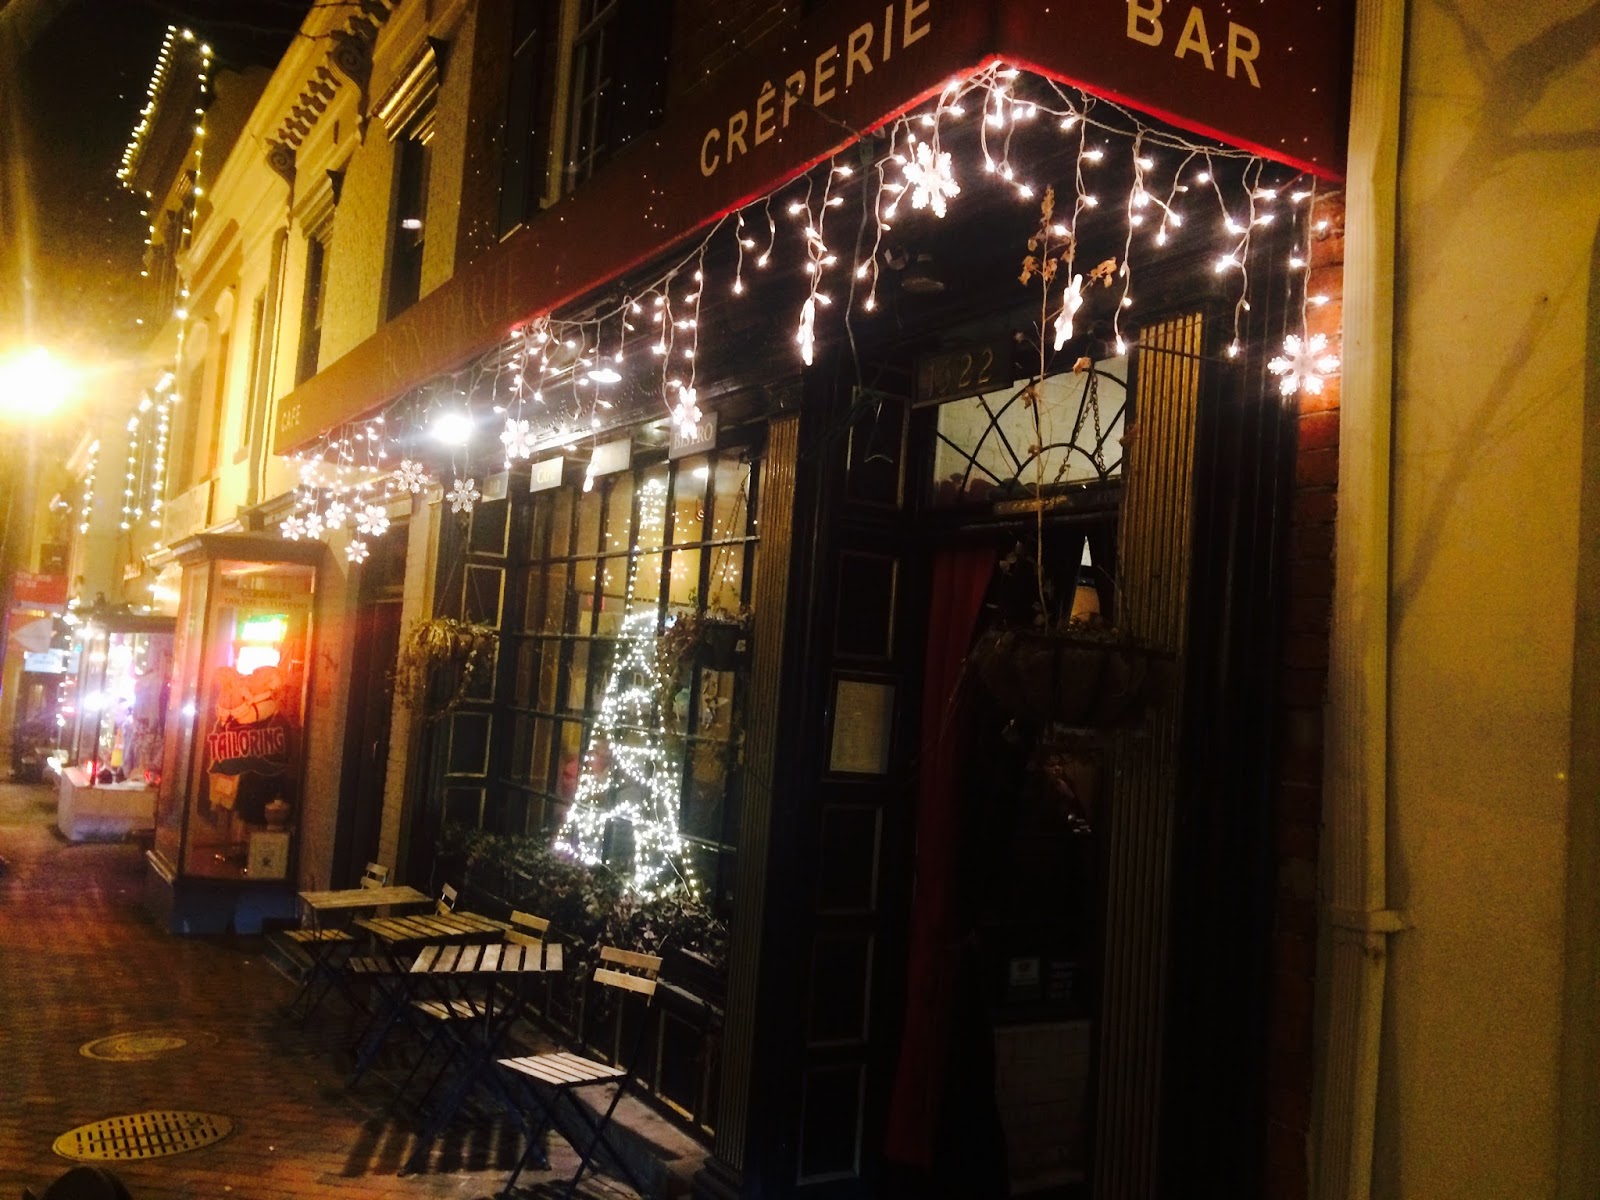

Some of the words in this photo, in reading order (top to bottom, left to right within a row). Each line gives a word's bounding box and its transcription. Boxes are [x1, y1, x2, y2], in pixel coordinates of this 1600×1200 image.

[700, 0, 931, 177] CRÊPERIE
[1126, 0, 1261, 89] BAR
[207, 726, 286, 763] TAILORING
